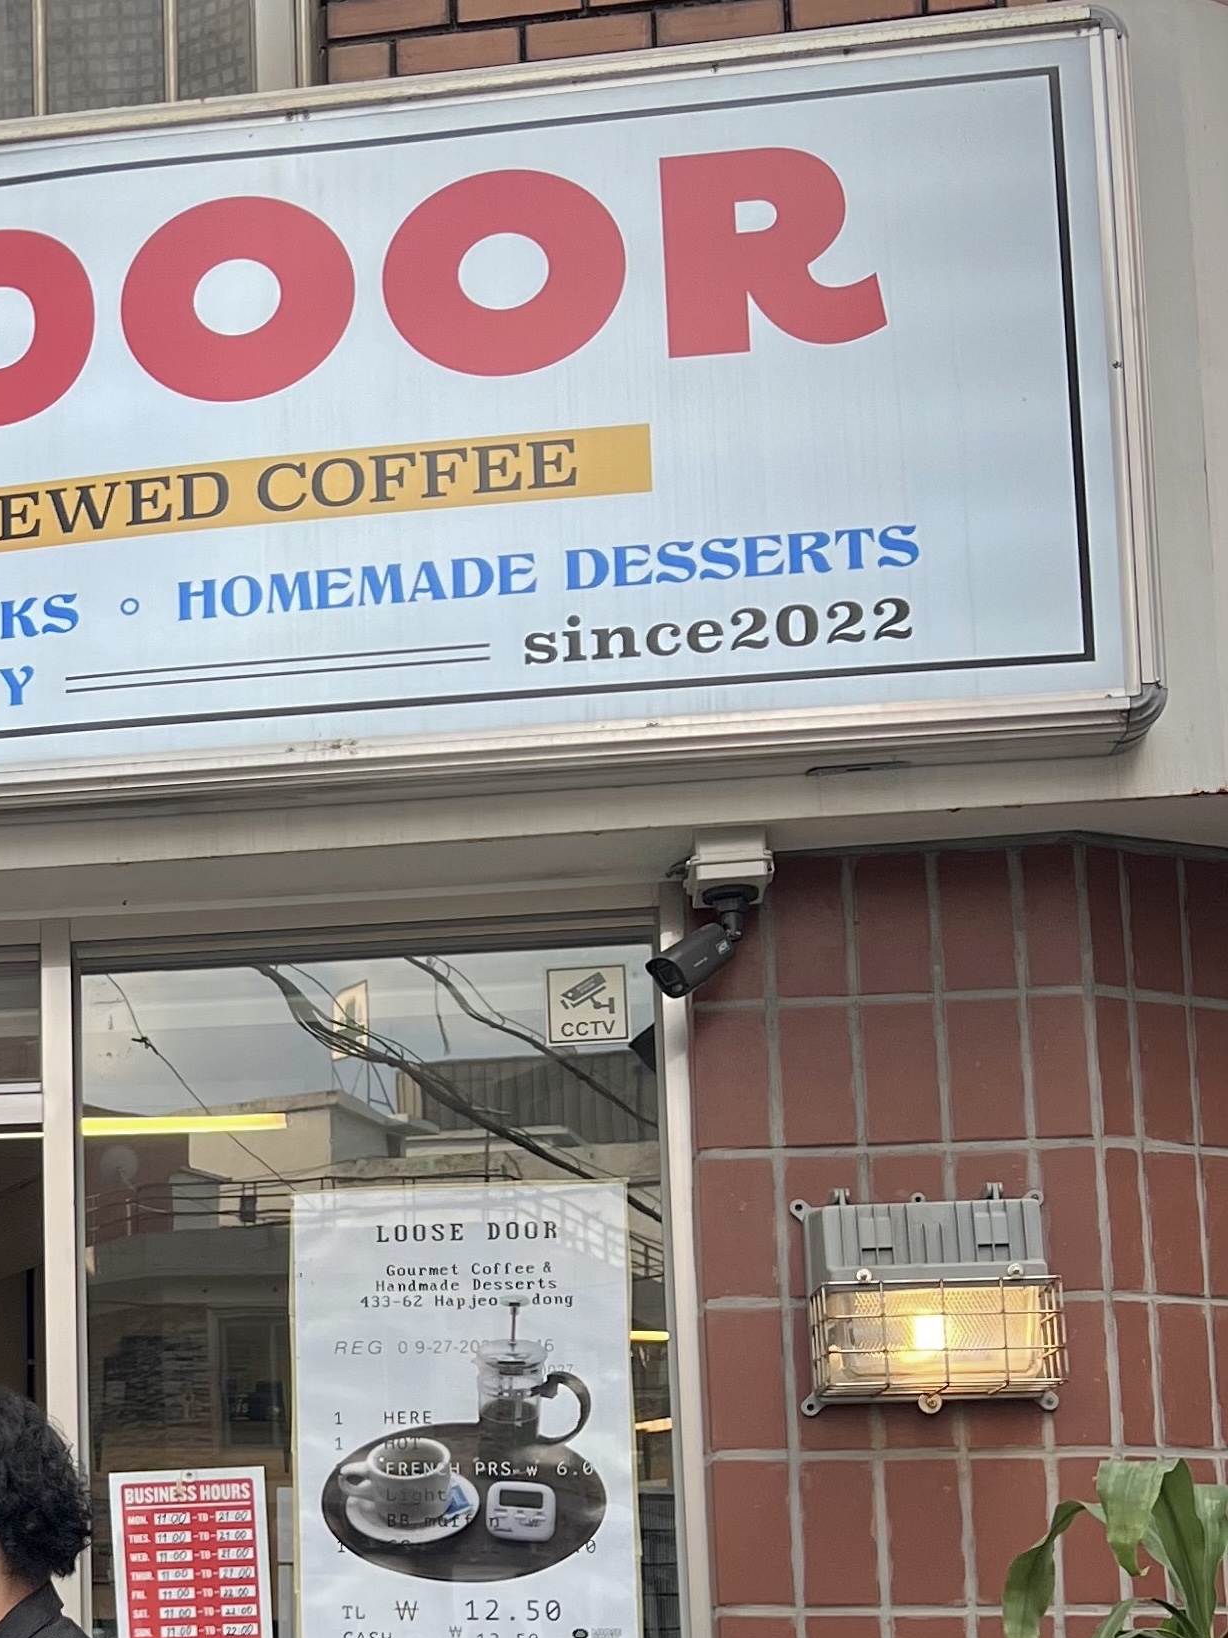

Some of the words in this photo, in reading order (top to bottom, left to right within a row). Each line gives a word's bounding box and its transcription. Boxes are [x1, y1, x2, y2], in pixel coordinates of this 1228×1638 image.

[257, 439, 577, 512] COFFEE
[178, 554, 536, 621] HOMEMADE
[566, 525, 920, 594] DESSERTS
[524, 599, 914, 665] since2022
[560, 1019, 616, 1038] CCTV
[375, 1223, 464, 1243] LOOSE
[487, 1221, 559, 1241] DOOR
[385, 1263, 459, 1277] Gourmet
[471, 1262, 536, 1275] Coffee
[542, 1261, 553, 1274] &
[375, 1278, 460, 1293] Handmade
[472, 1277, 558, 1291] Desserts
[360, 1295, 423, 1309] 433-62
[333, 1339, 383, 1356] REG
[334, 1411, 343, 1425] 1
[383, 1410, 433, 1425] HERE
[334, 1437, 344, 1451] 1
[383, 1436, 423, 1450] HOT
[384, 1461, 461, 1476] FRENCH
[124, 1486, 197, 1505] BUSINESS
[199, 1482, 251, 1501] HOURS
[385, 1488, 448, 1507] Light
[387, 1513, 410, 1528] BB
[424, 1513, 500, 1529] muffn
[342, 1605, 366, 1621] TL
[465, 1599, 562, 1622] 12.50
